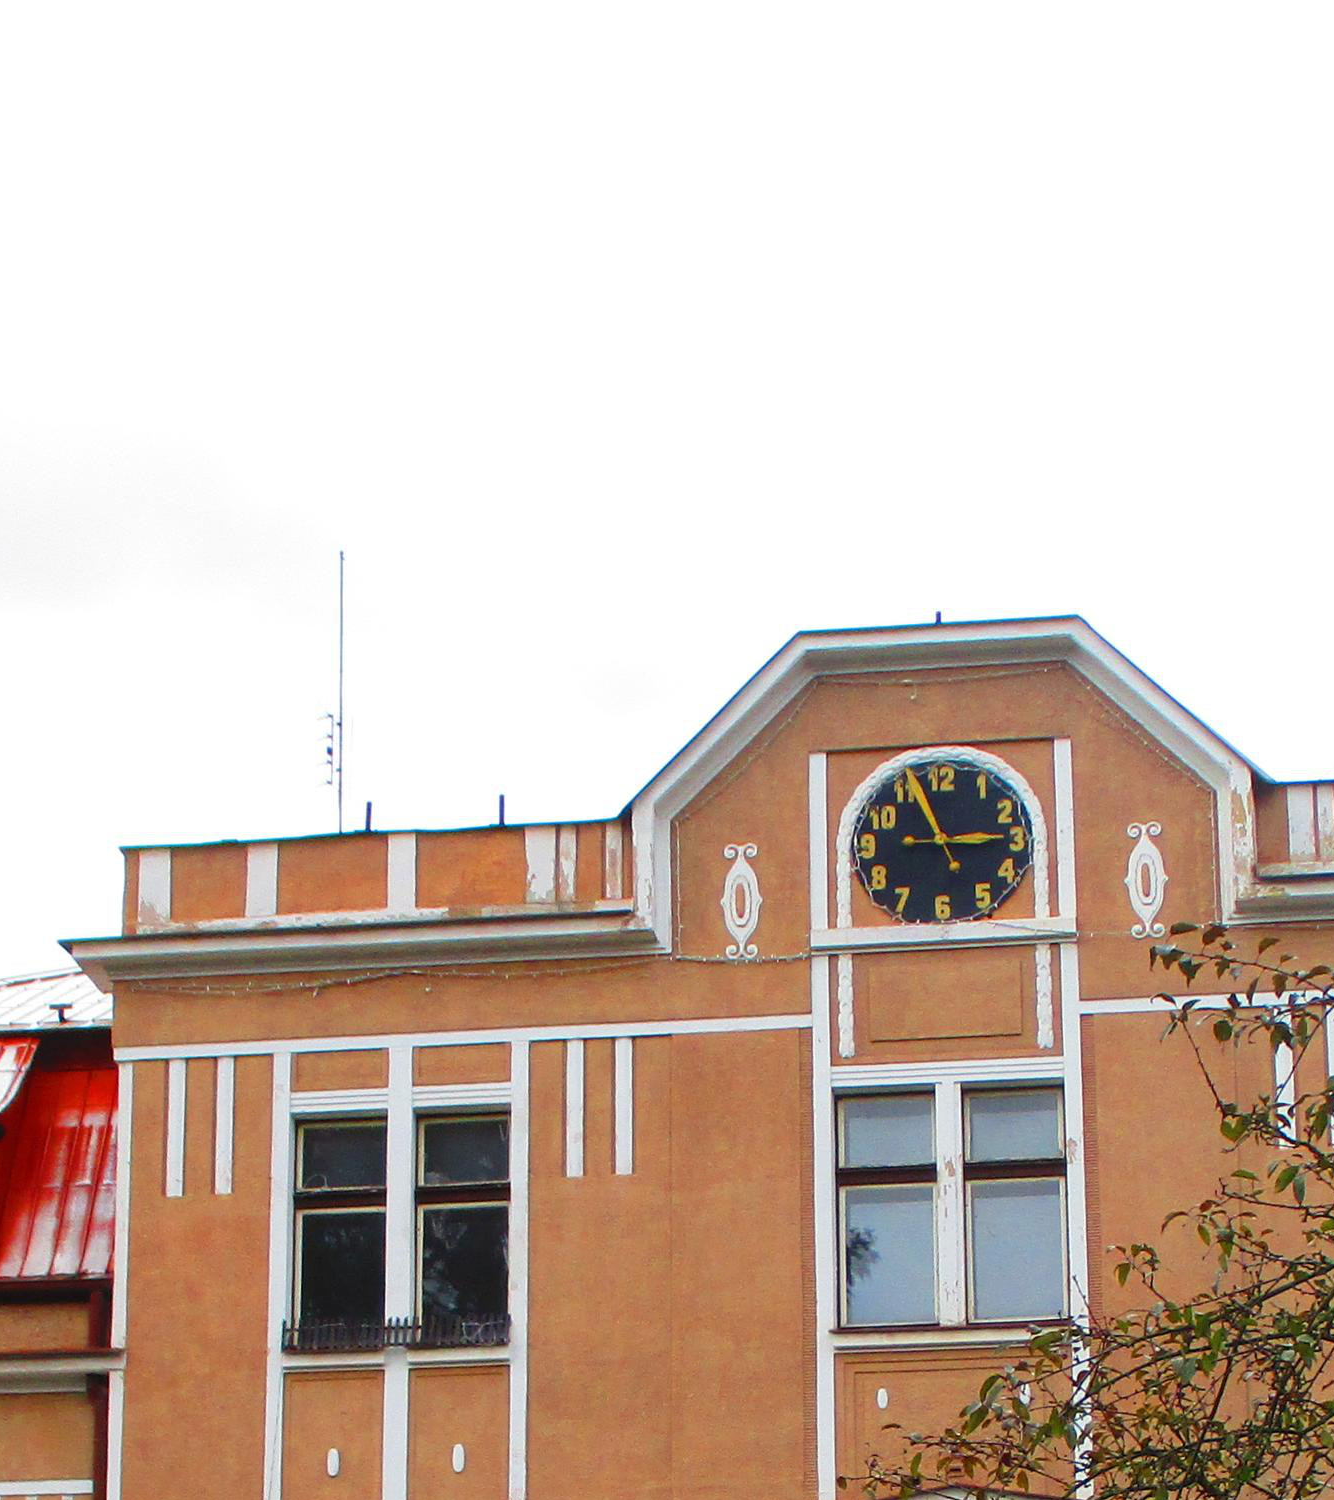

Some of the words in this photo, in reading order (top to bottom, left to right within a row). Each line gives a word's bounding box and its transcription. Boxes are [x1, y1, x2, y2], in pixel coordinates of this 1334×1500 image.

[894, 776, 916, 804] 11
[928, 767, 956, 791] 12
[976, 773, 987, 799] 1
[869, 805, 896, 830] 10
[997, 799, 1013, 824] 2
[858, 834, 876, 859] 9
[1009, 826, 1025, 852] 3
[871, 865, 887, 890] 8
[997, 858, 1015, 884] 4
[895, 886, 911, 913] 7
[934, 895, 951, 919] 6
[975, 882, 991, 909] 5
